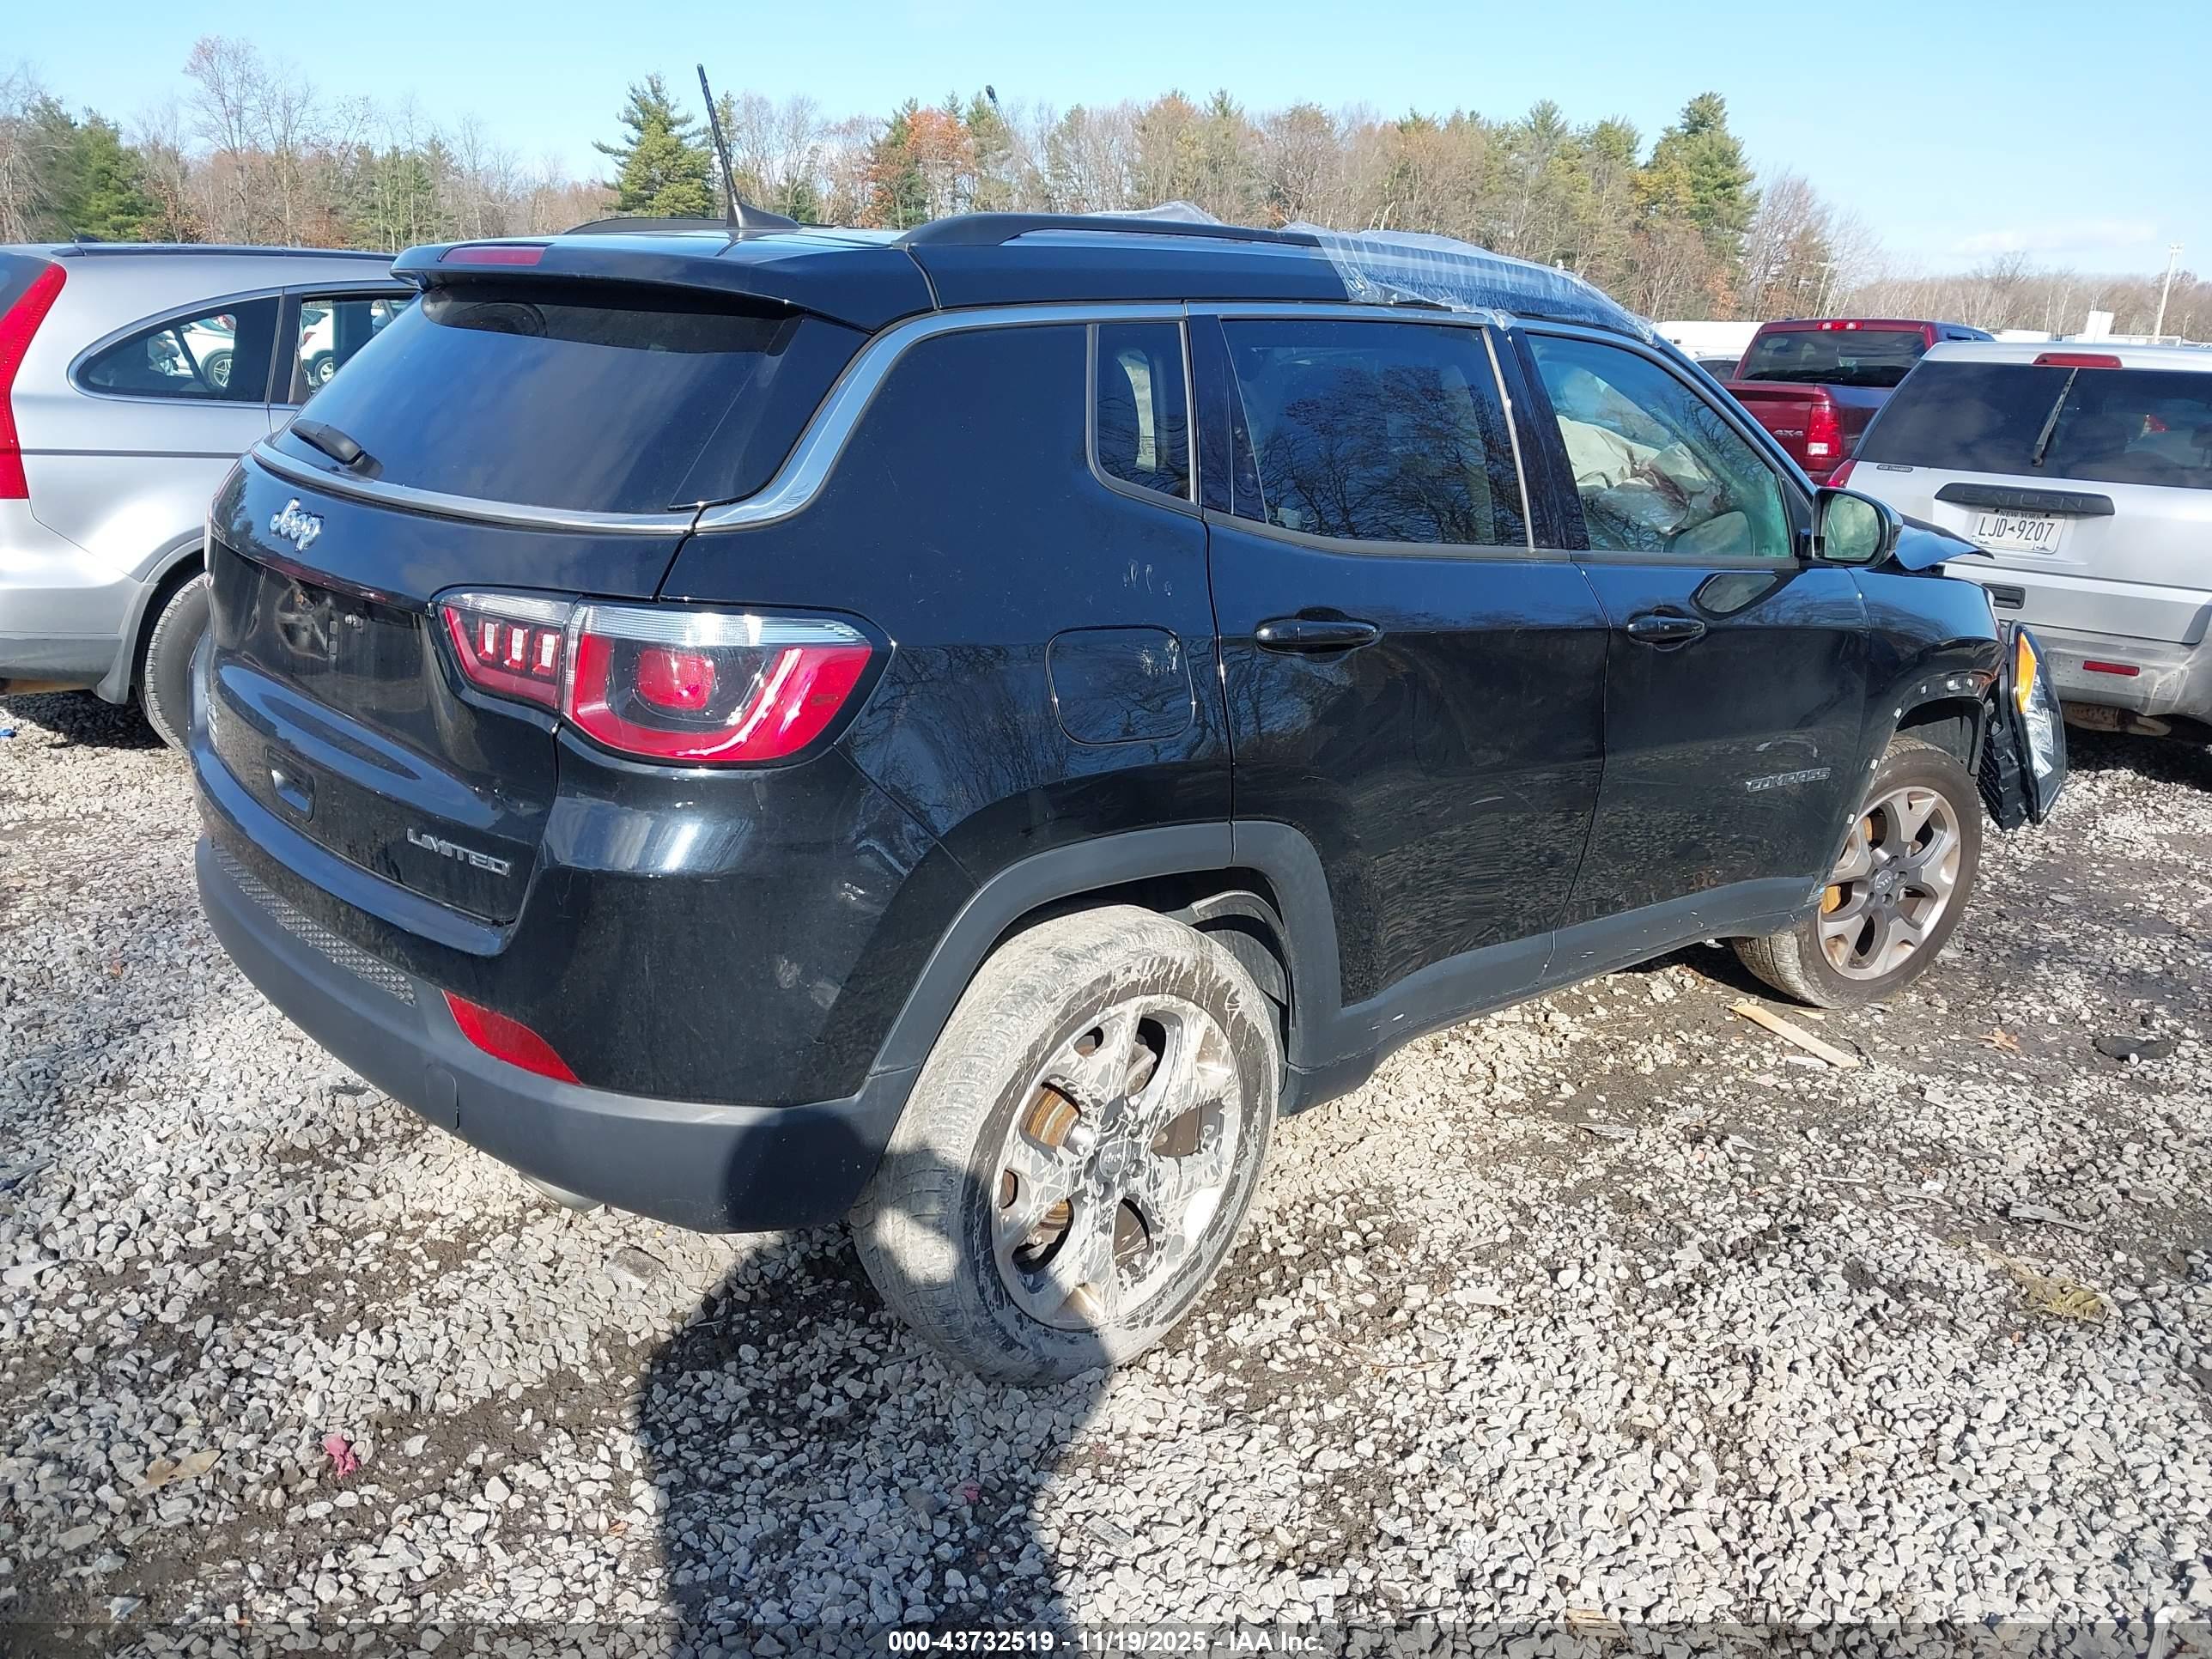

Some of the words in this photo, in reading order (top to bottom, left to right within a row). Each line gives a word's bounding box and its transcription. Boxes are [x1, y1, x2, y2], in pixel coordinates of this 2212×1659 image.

[269, 498, 322, 551] Jeep
[1999, 510, 2019, 519] NEW
[2019, 512, 2042, 520] YORK
[1746, 768, 1832, 793] COMPASS
[407, 828, 510, 877] LIMITED
